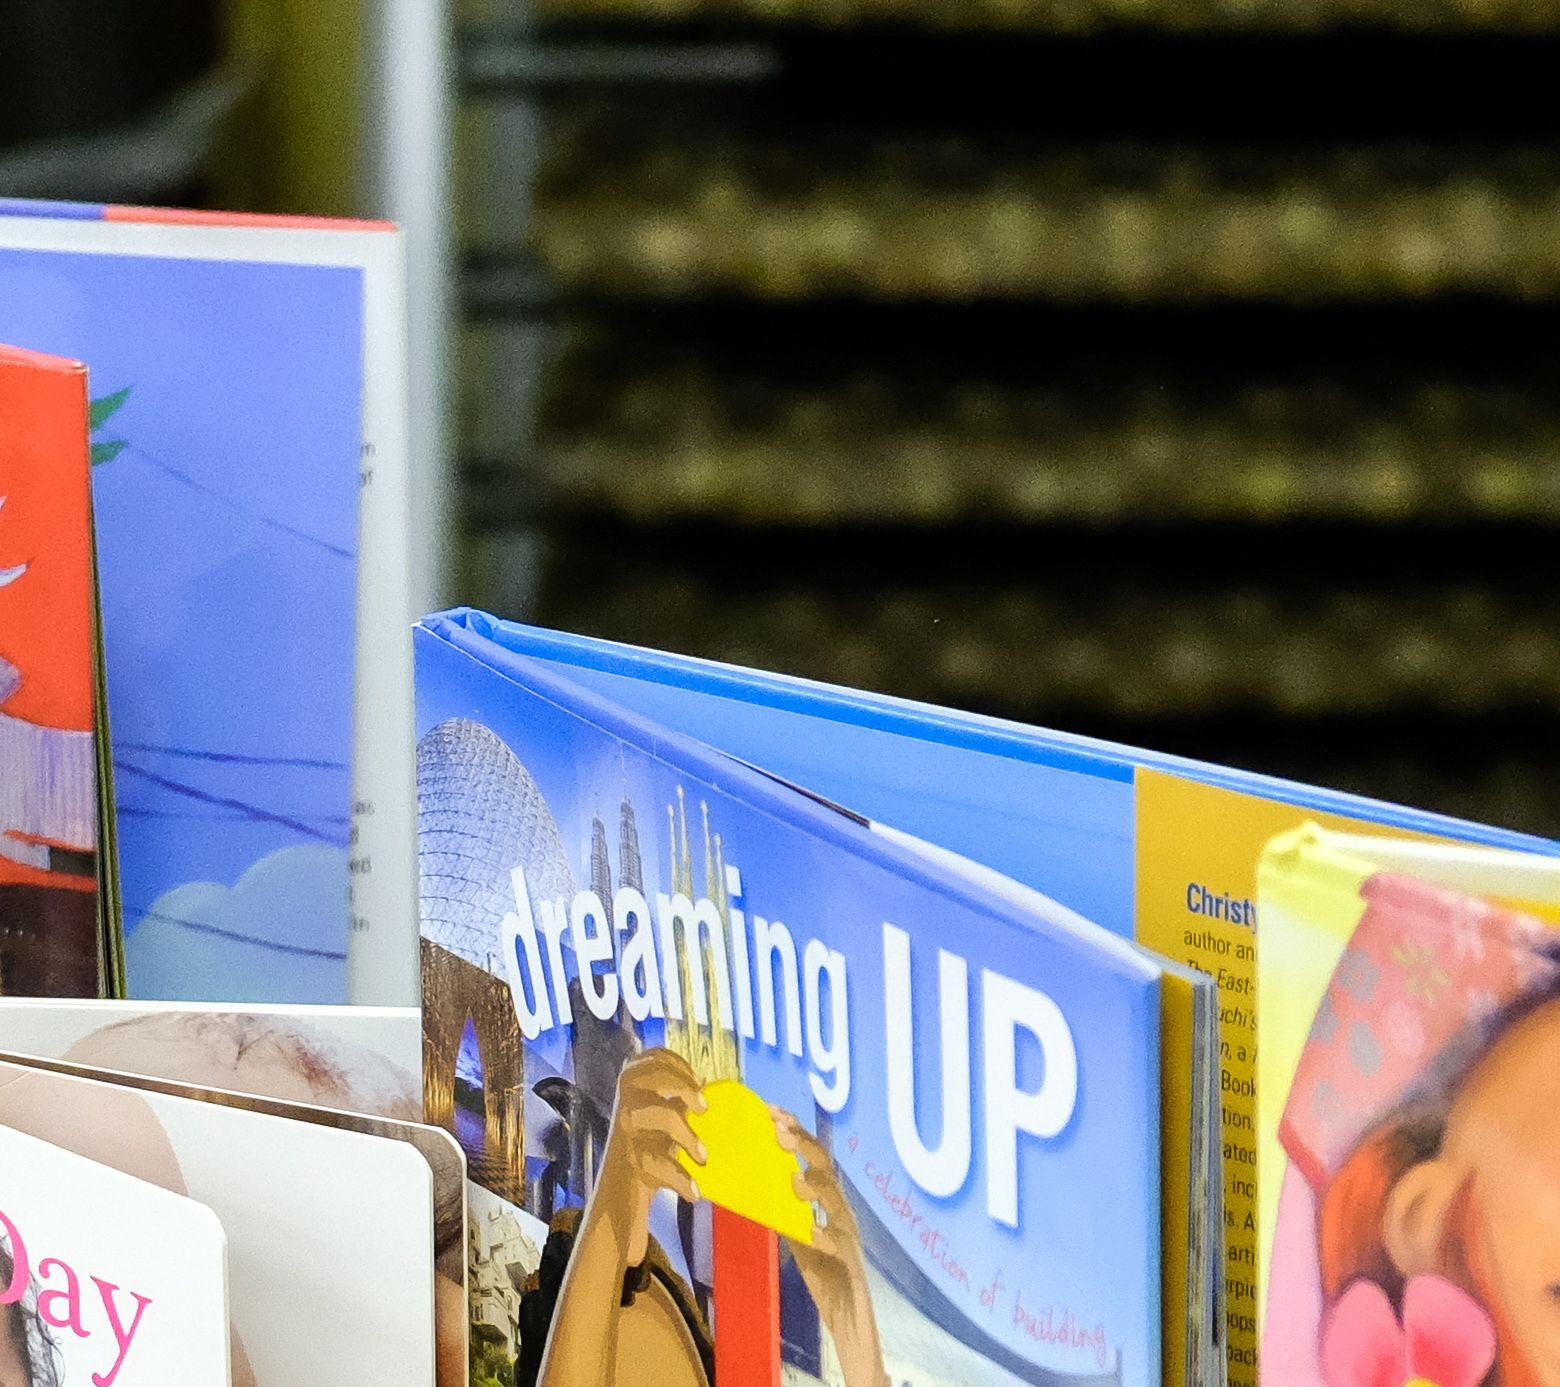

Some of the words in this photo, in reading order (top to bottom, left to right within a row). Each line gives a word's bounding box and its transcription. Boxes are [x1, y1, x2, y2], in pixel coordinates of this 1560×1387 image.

[1183, 929, 1233, 957] author
[500, 865, 853, 1115] dreaming
[882, 921, 1079, 1229] UP
